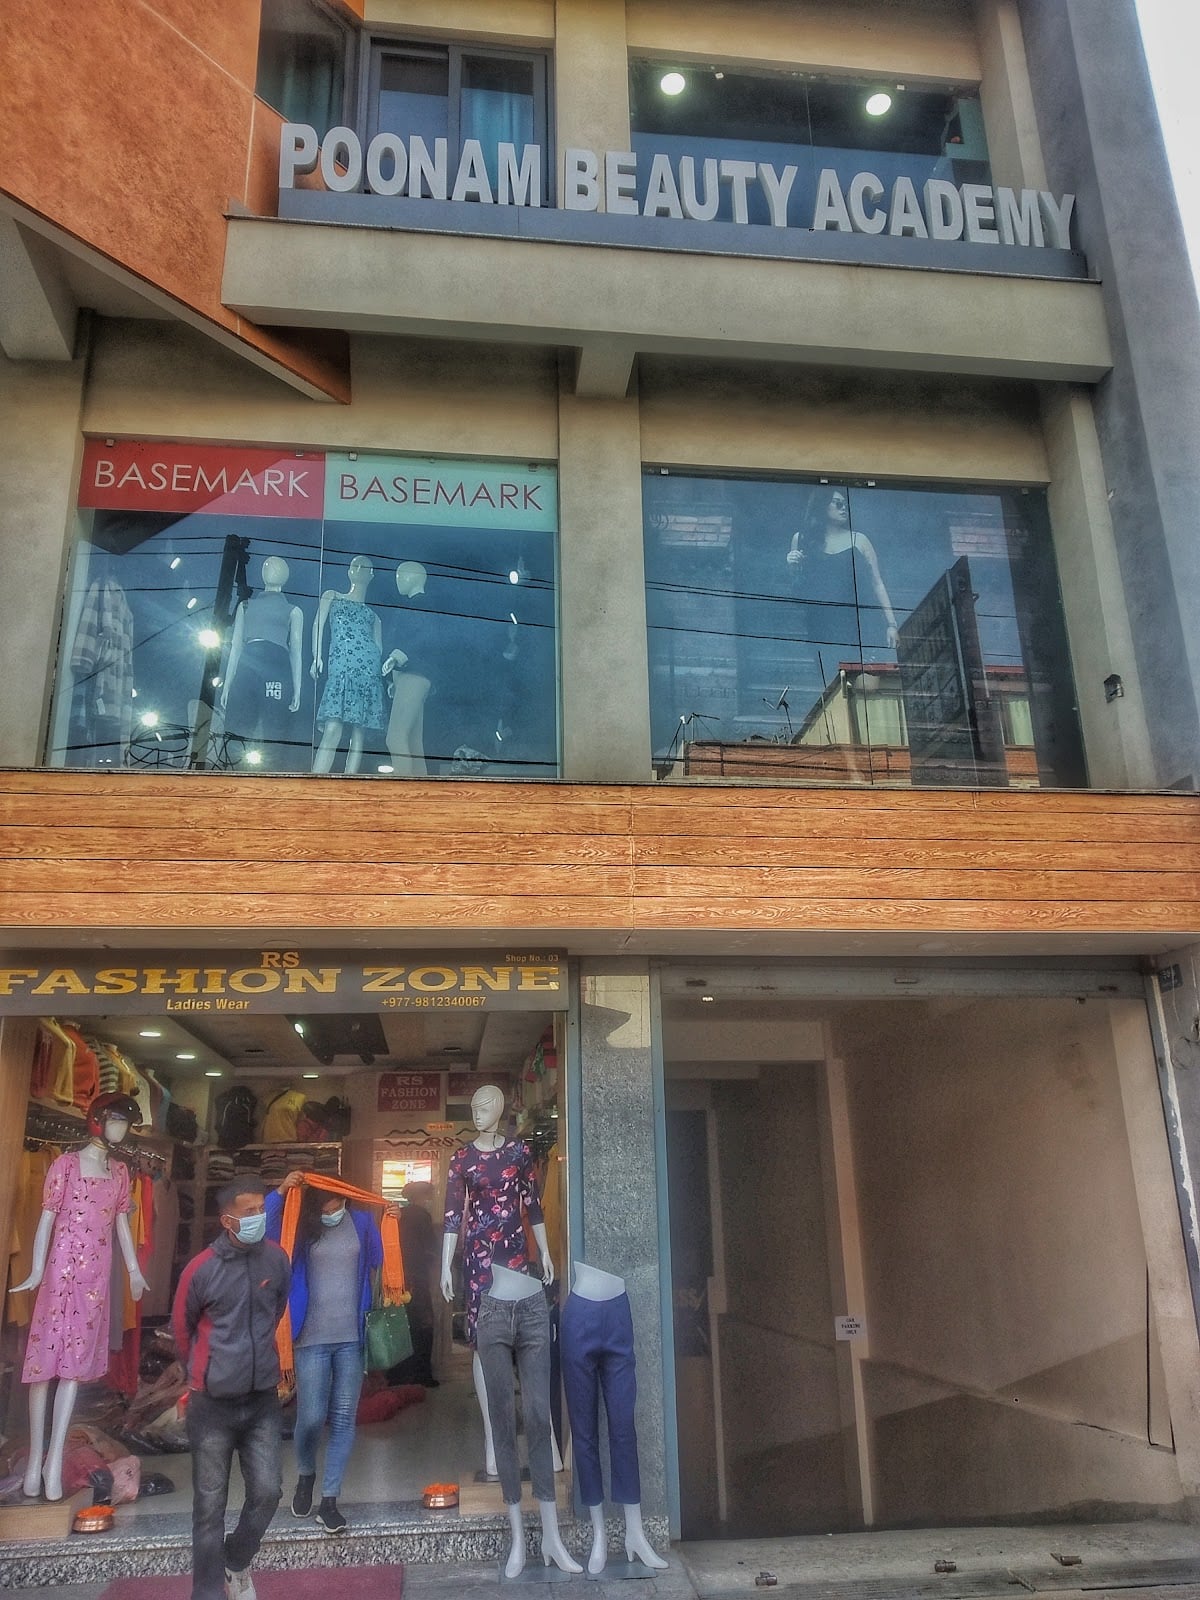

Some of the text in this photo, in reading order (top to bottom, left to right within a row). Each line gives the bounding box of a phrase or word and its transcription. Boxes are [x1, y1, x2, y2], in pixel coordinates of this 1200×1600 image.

[279, 122, 1076, 250] POONAM BEAUTY ACADEMY
[94, 460, 310, 498] BASEMARK
[340, 473, 544, 511] BASEMARK
[260, 951, 300, 968] RS
[505, 953, 528, 963] Shop
[548, 954, 559, 962] 03
[0, 966, 560, 995] FASHION ZONE
[166, 998, 250, 1010] Ladies Wear
[381, 996, 487, 1008] +977-9812340067
[396, 1075, 423, 1086] RS
[381, 1087, 438, 1098] FASHION
[391, 1100, 427, 1110] ZONE
